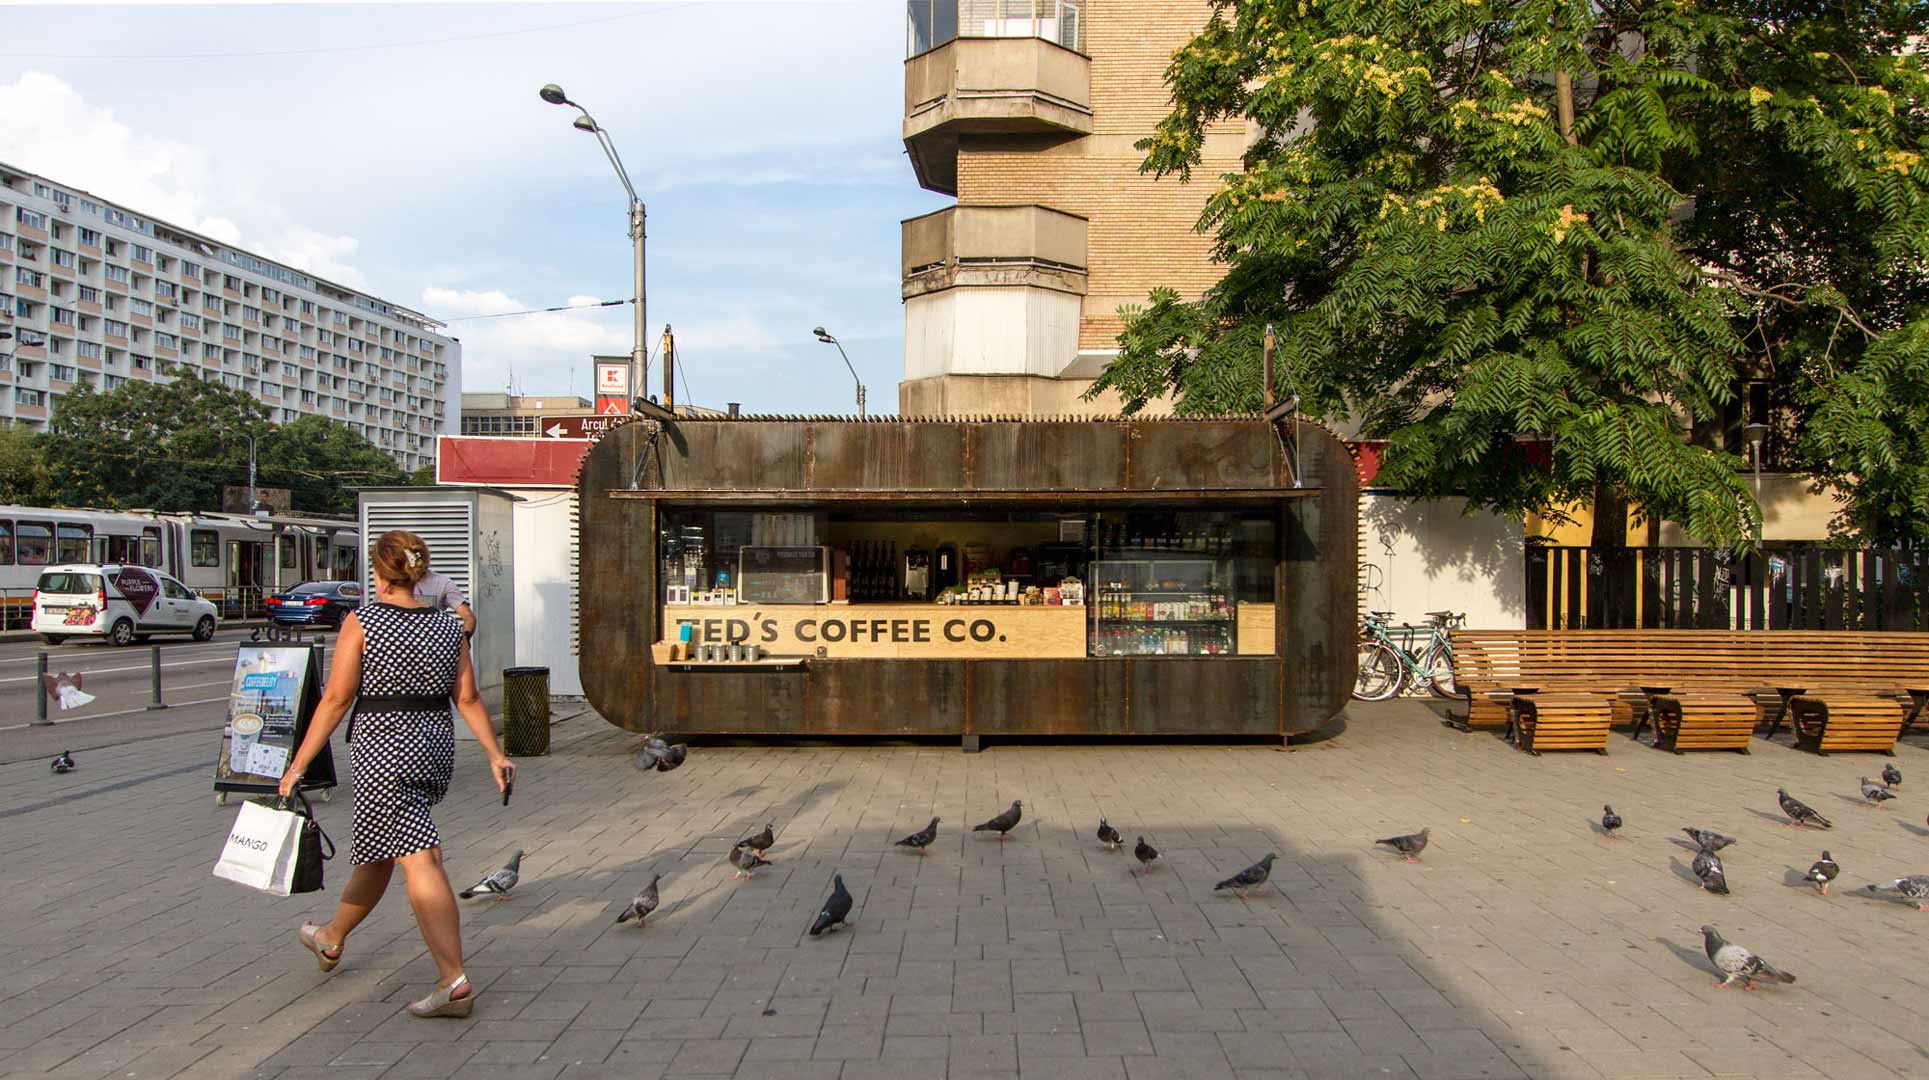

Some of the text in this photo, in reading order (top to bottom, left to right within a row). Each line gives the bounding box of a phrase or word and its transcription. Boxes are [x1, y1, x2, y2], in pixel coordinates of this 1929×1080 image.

[581, 418, 608, 430] Arcul
[794, 619, 930, 642] COFFEE
[944, 619, 1006, 642] CO.
[230, 834, 268, 852] MANGO
